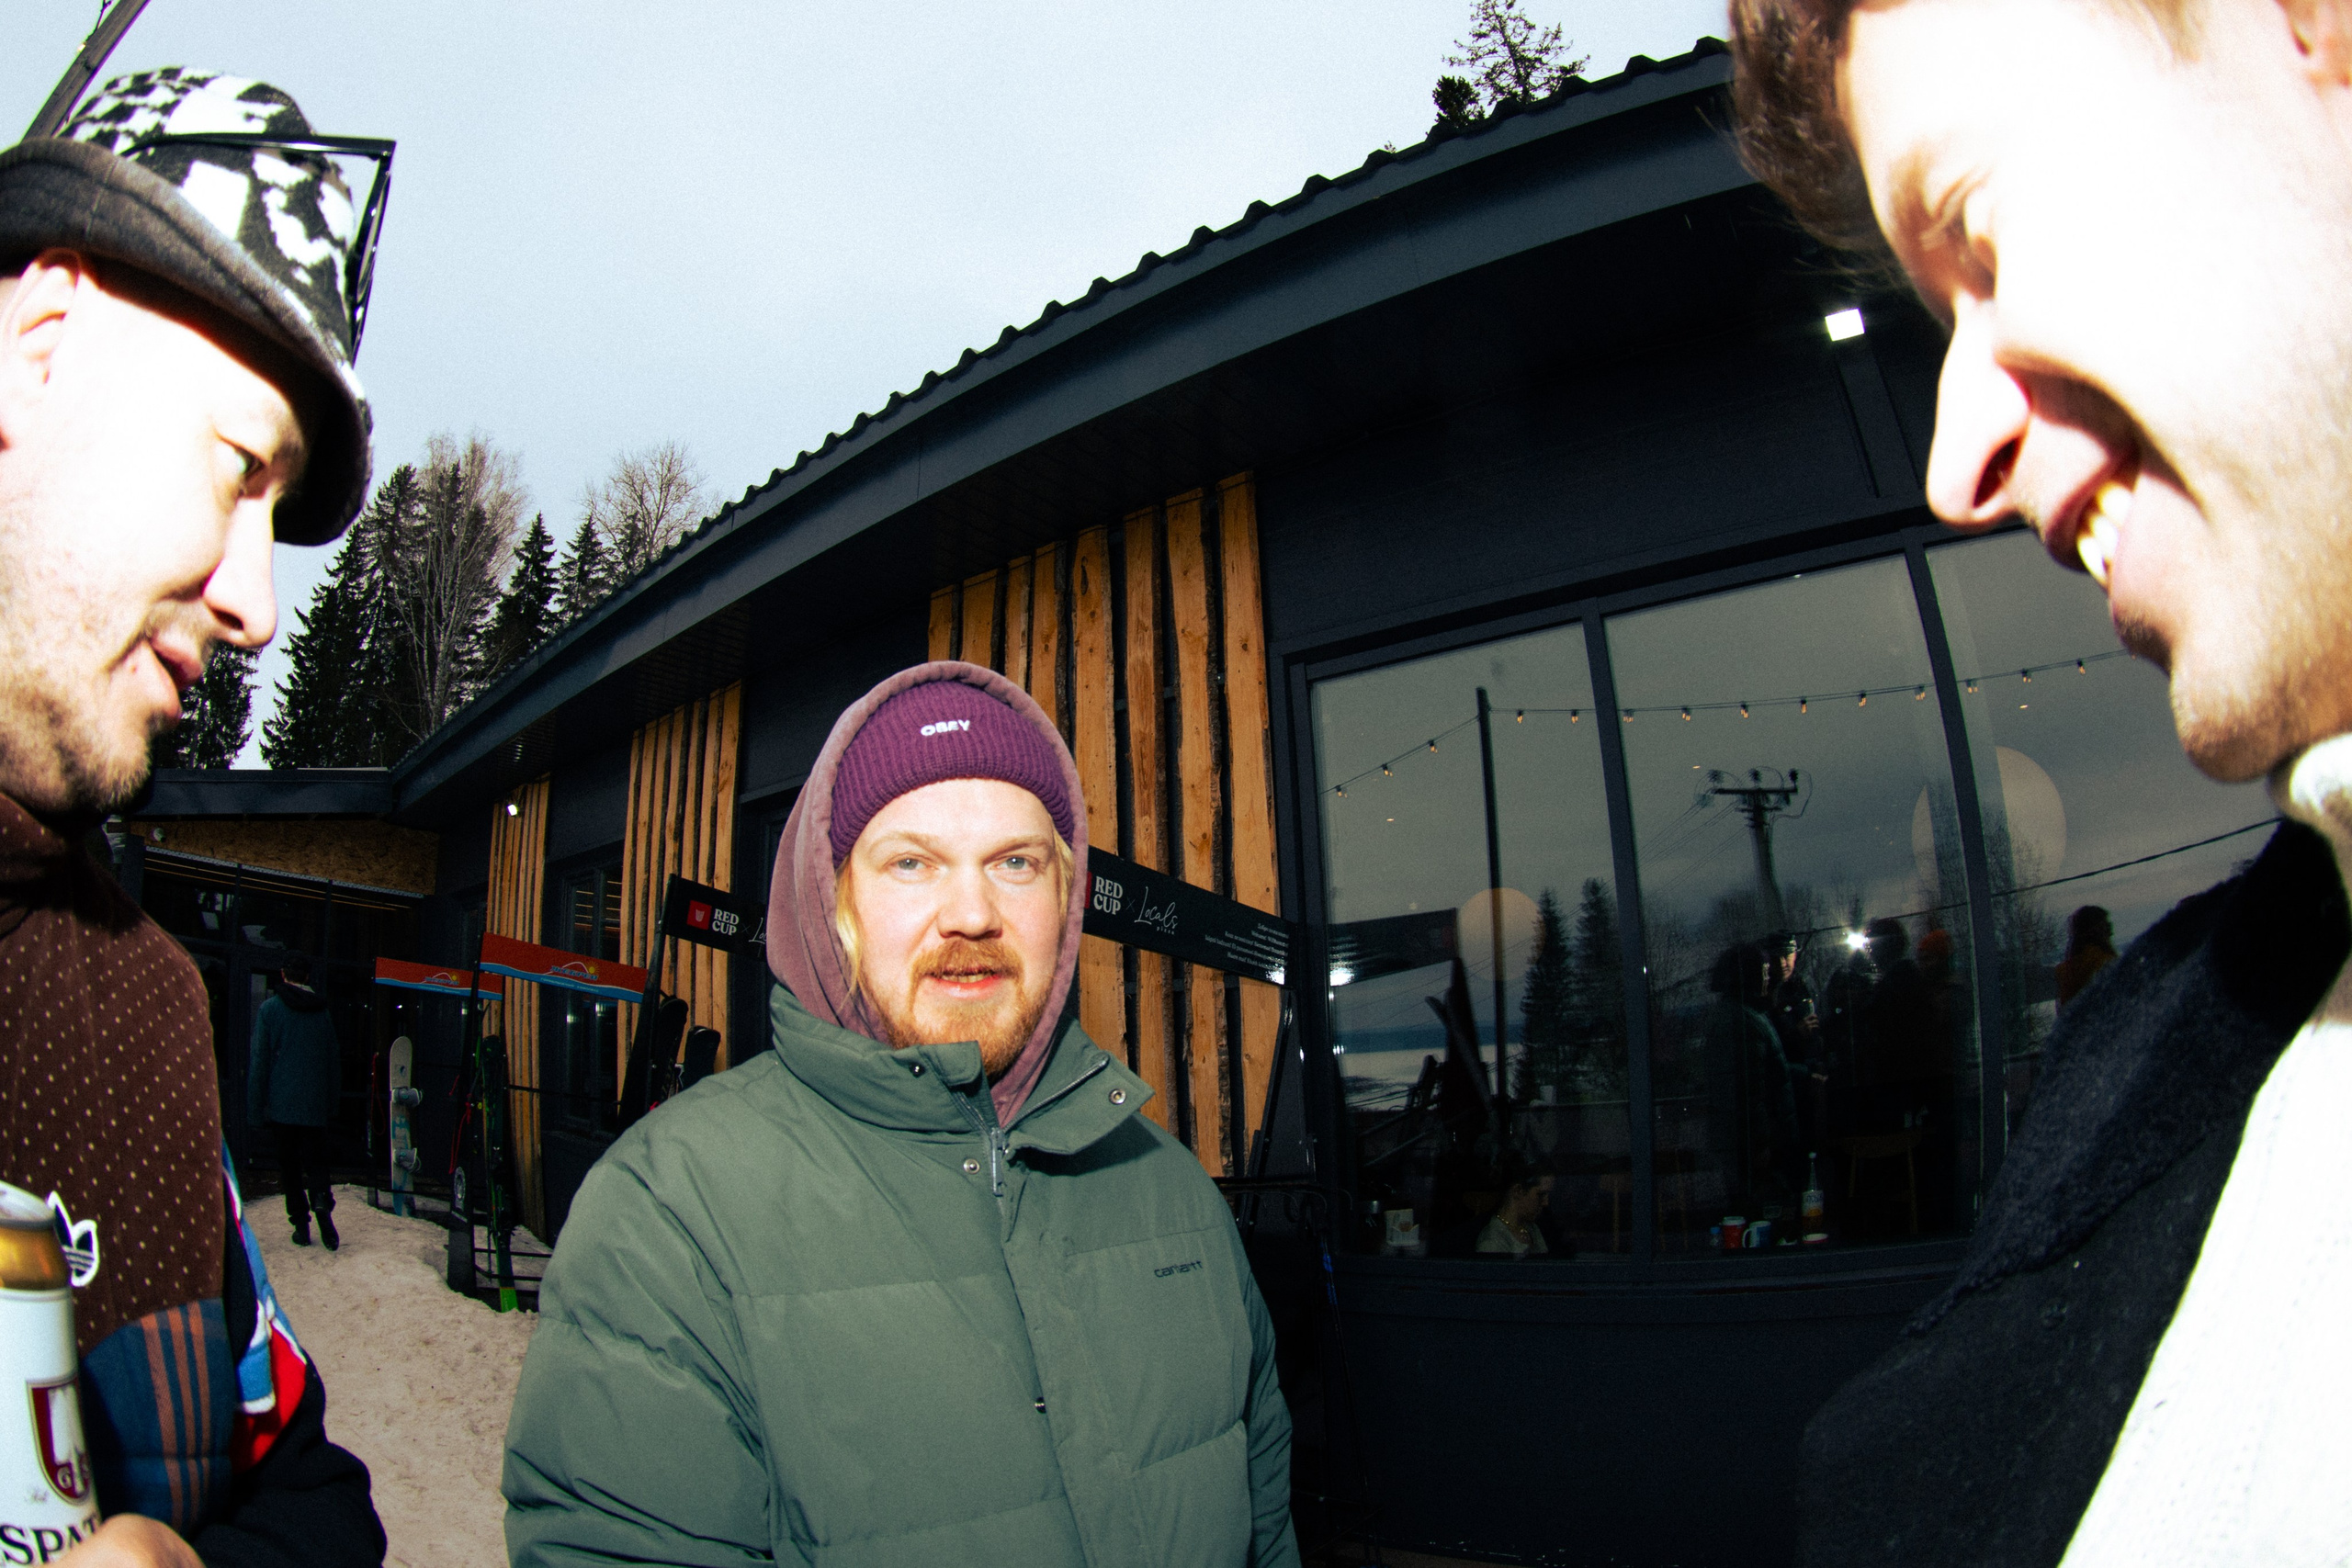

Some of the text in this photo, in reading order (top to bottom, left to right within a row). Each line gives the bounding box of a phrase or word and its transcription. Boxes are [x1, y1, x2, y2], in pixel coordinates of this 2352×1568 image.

[921, 719, 970, 736] OBEY
[1094, 876, 1124, 899] RED
[1093, 894, 1122, 915] CUP
[1134, 886, 1179, 930] Locals
[713, 908, 740, 925] RED
[712, 921, 738, 936] CUP
[748, 917, 767, 944] Loc
